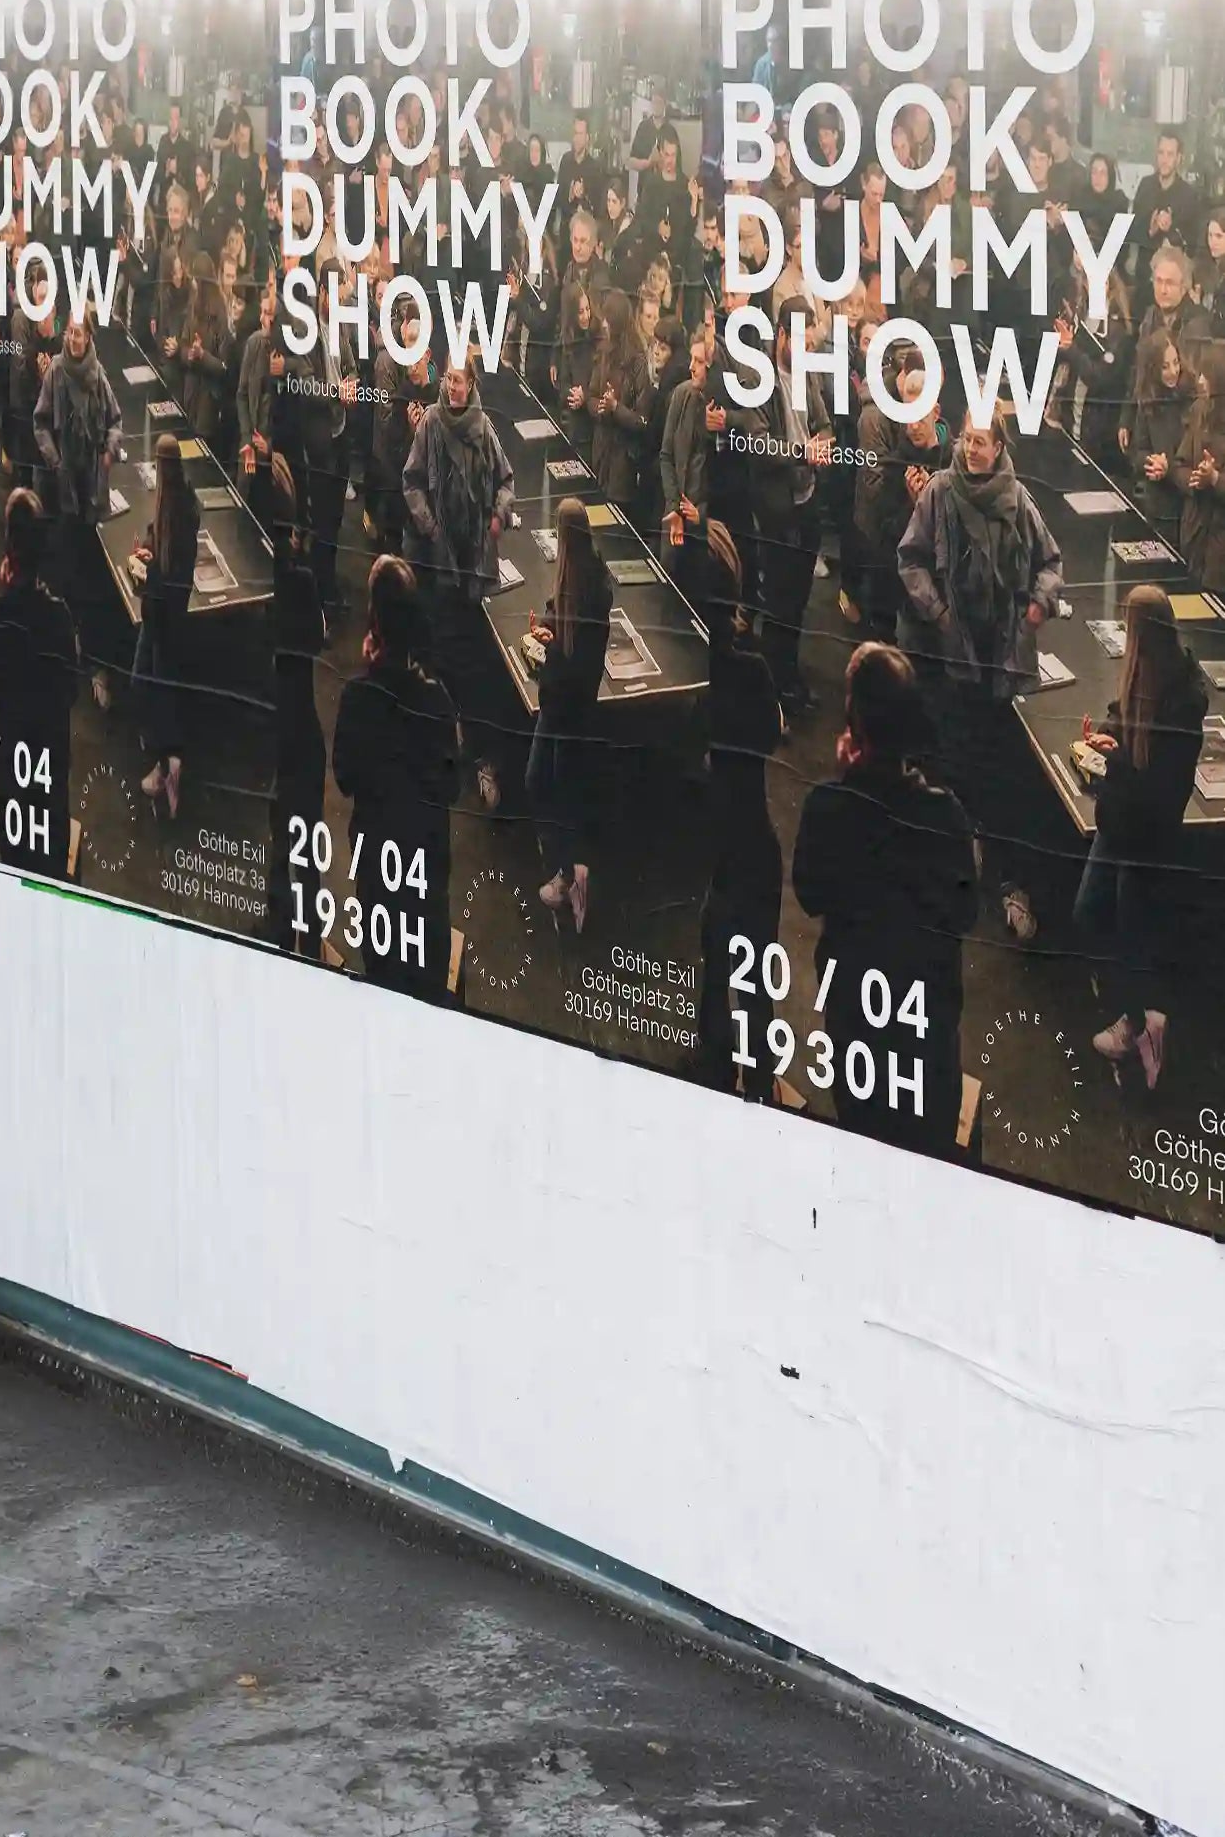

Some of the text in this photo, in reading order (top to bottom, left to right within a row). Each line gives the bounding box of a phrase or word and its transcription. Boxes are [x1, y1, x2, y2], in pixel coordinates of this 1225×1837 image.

[280, 74, 495, 168] BOOK
[722, 81, 1039, 194] BOOK
[281, 172, 559, 273] DUMMY
[723, 194, 1135, 320] DUMMY
[281, 267, 511, 374] SHOW
[285, 373, 389, 405] fotobuchklasse
[721, 305, 1061, 437] SHOW
[728, 428, 878, 468] fotobuchklasse
[14, 740, 52, 794] 04
[174, 847, 266, 891] Götheplatz 3a
[198, 828, 265, 864] Göthe Exil
[288, 814, 428, 900] 20 / 04
[160, 869, 266, 918] 30169 Hannover
[290, 879, 425, 969] 1930H
[581, 965, 696, 1019] Götheplatz 3a
[610, 944, 695, 989] Göthe Exil
[728, 933, 929, 1040] 20 / 04
[563, 989, 697, 1049] 30169 Hannover
[730, 1006, 924, 1118] 1930H
[1127, 1153, 1200, 1198] 30169
